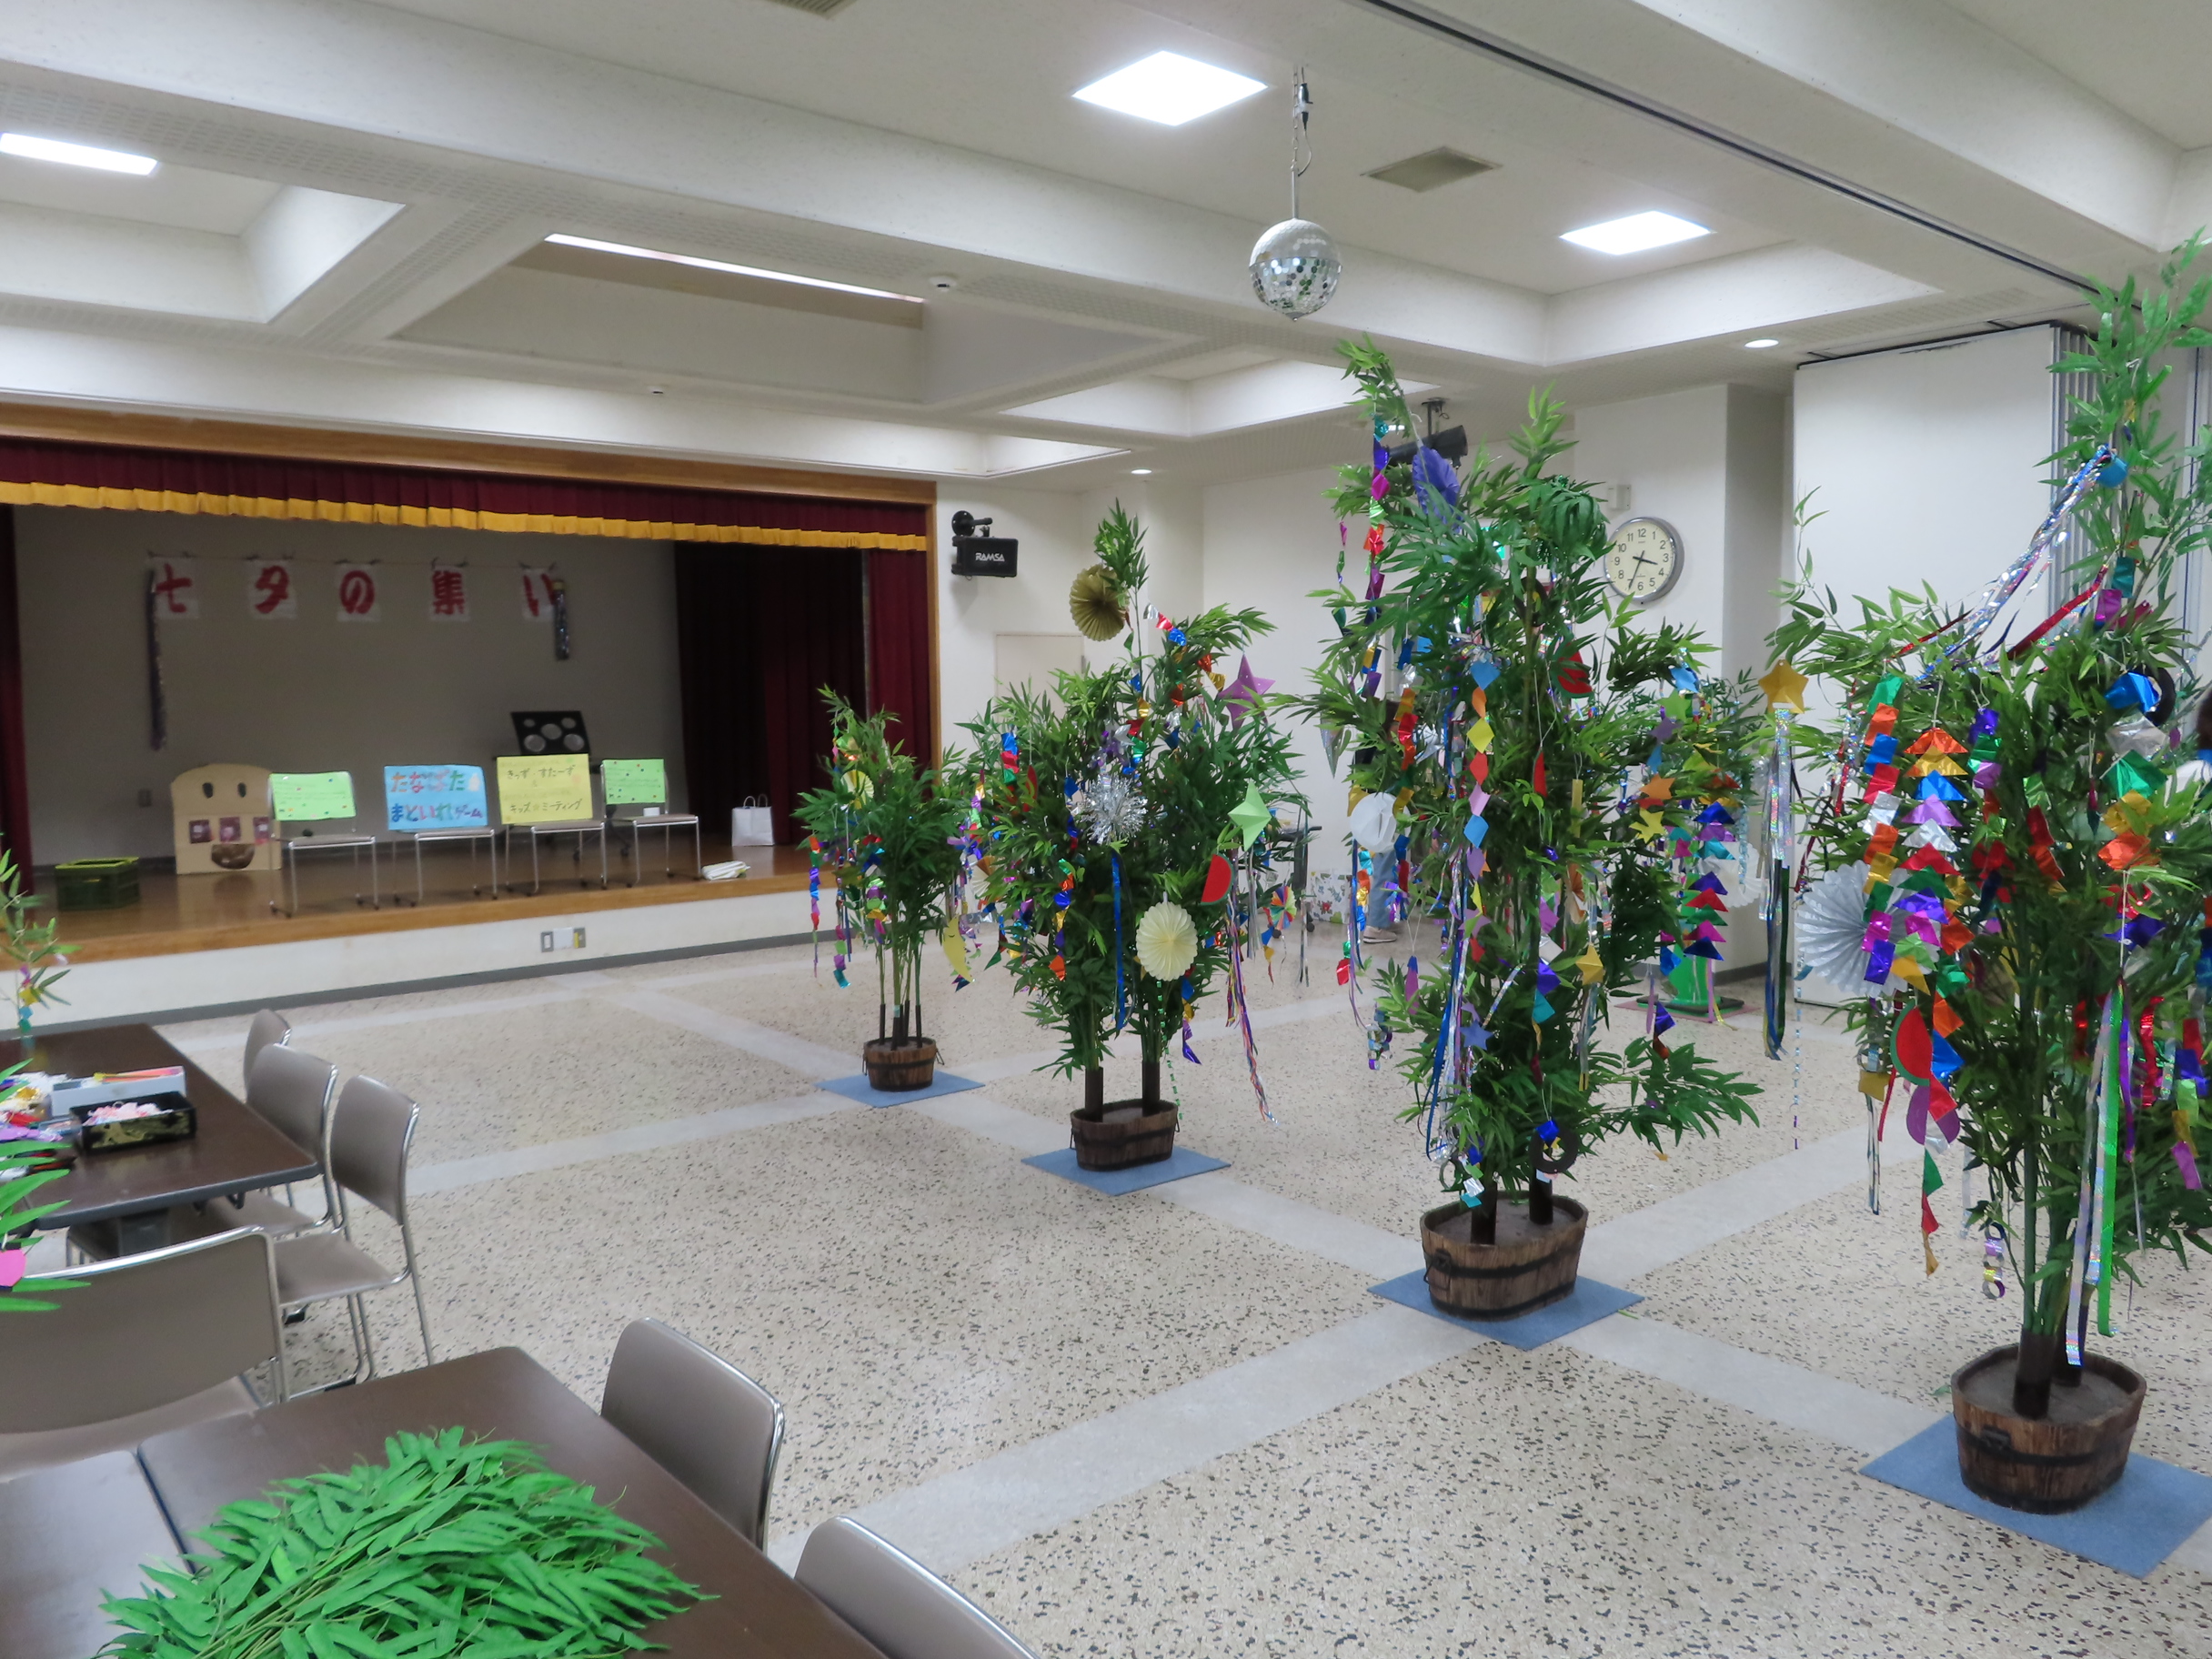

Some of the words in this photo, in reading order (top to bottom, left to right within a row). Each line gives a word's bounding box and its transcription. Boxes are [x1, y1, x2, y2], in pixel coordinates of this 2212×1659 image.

[1627, 533, 1634, 541] 11
[1637, 528, 1646, 538] 12
[1652, 531, 1656, 540] 1
[1617, 543, 1627, 553] 10
[1659, 539, 1666, 549] 2
[975, 552, 1005, 562] RAMSA
[1614, 557, 1620, 566] 9
[1663, 553, 1669, 563] 3
[1618, 569, 1624, 579] 8
[1658, 568, 1664, 576] 4
[1637, 582, 1644, 590] 6
[1649, 578, 1655, 587] 5
[156, 562, 556, 618] 七夕の集い
